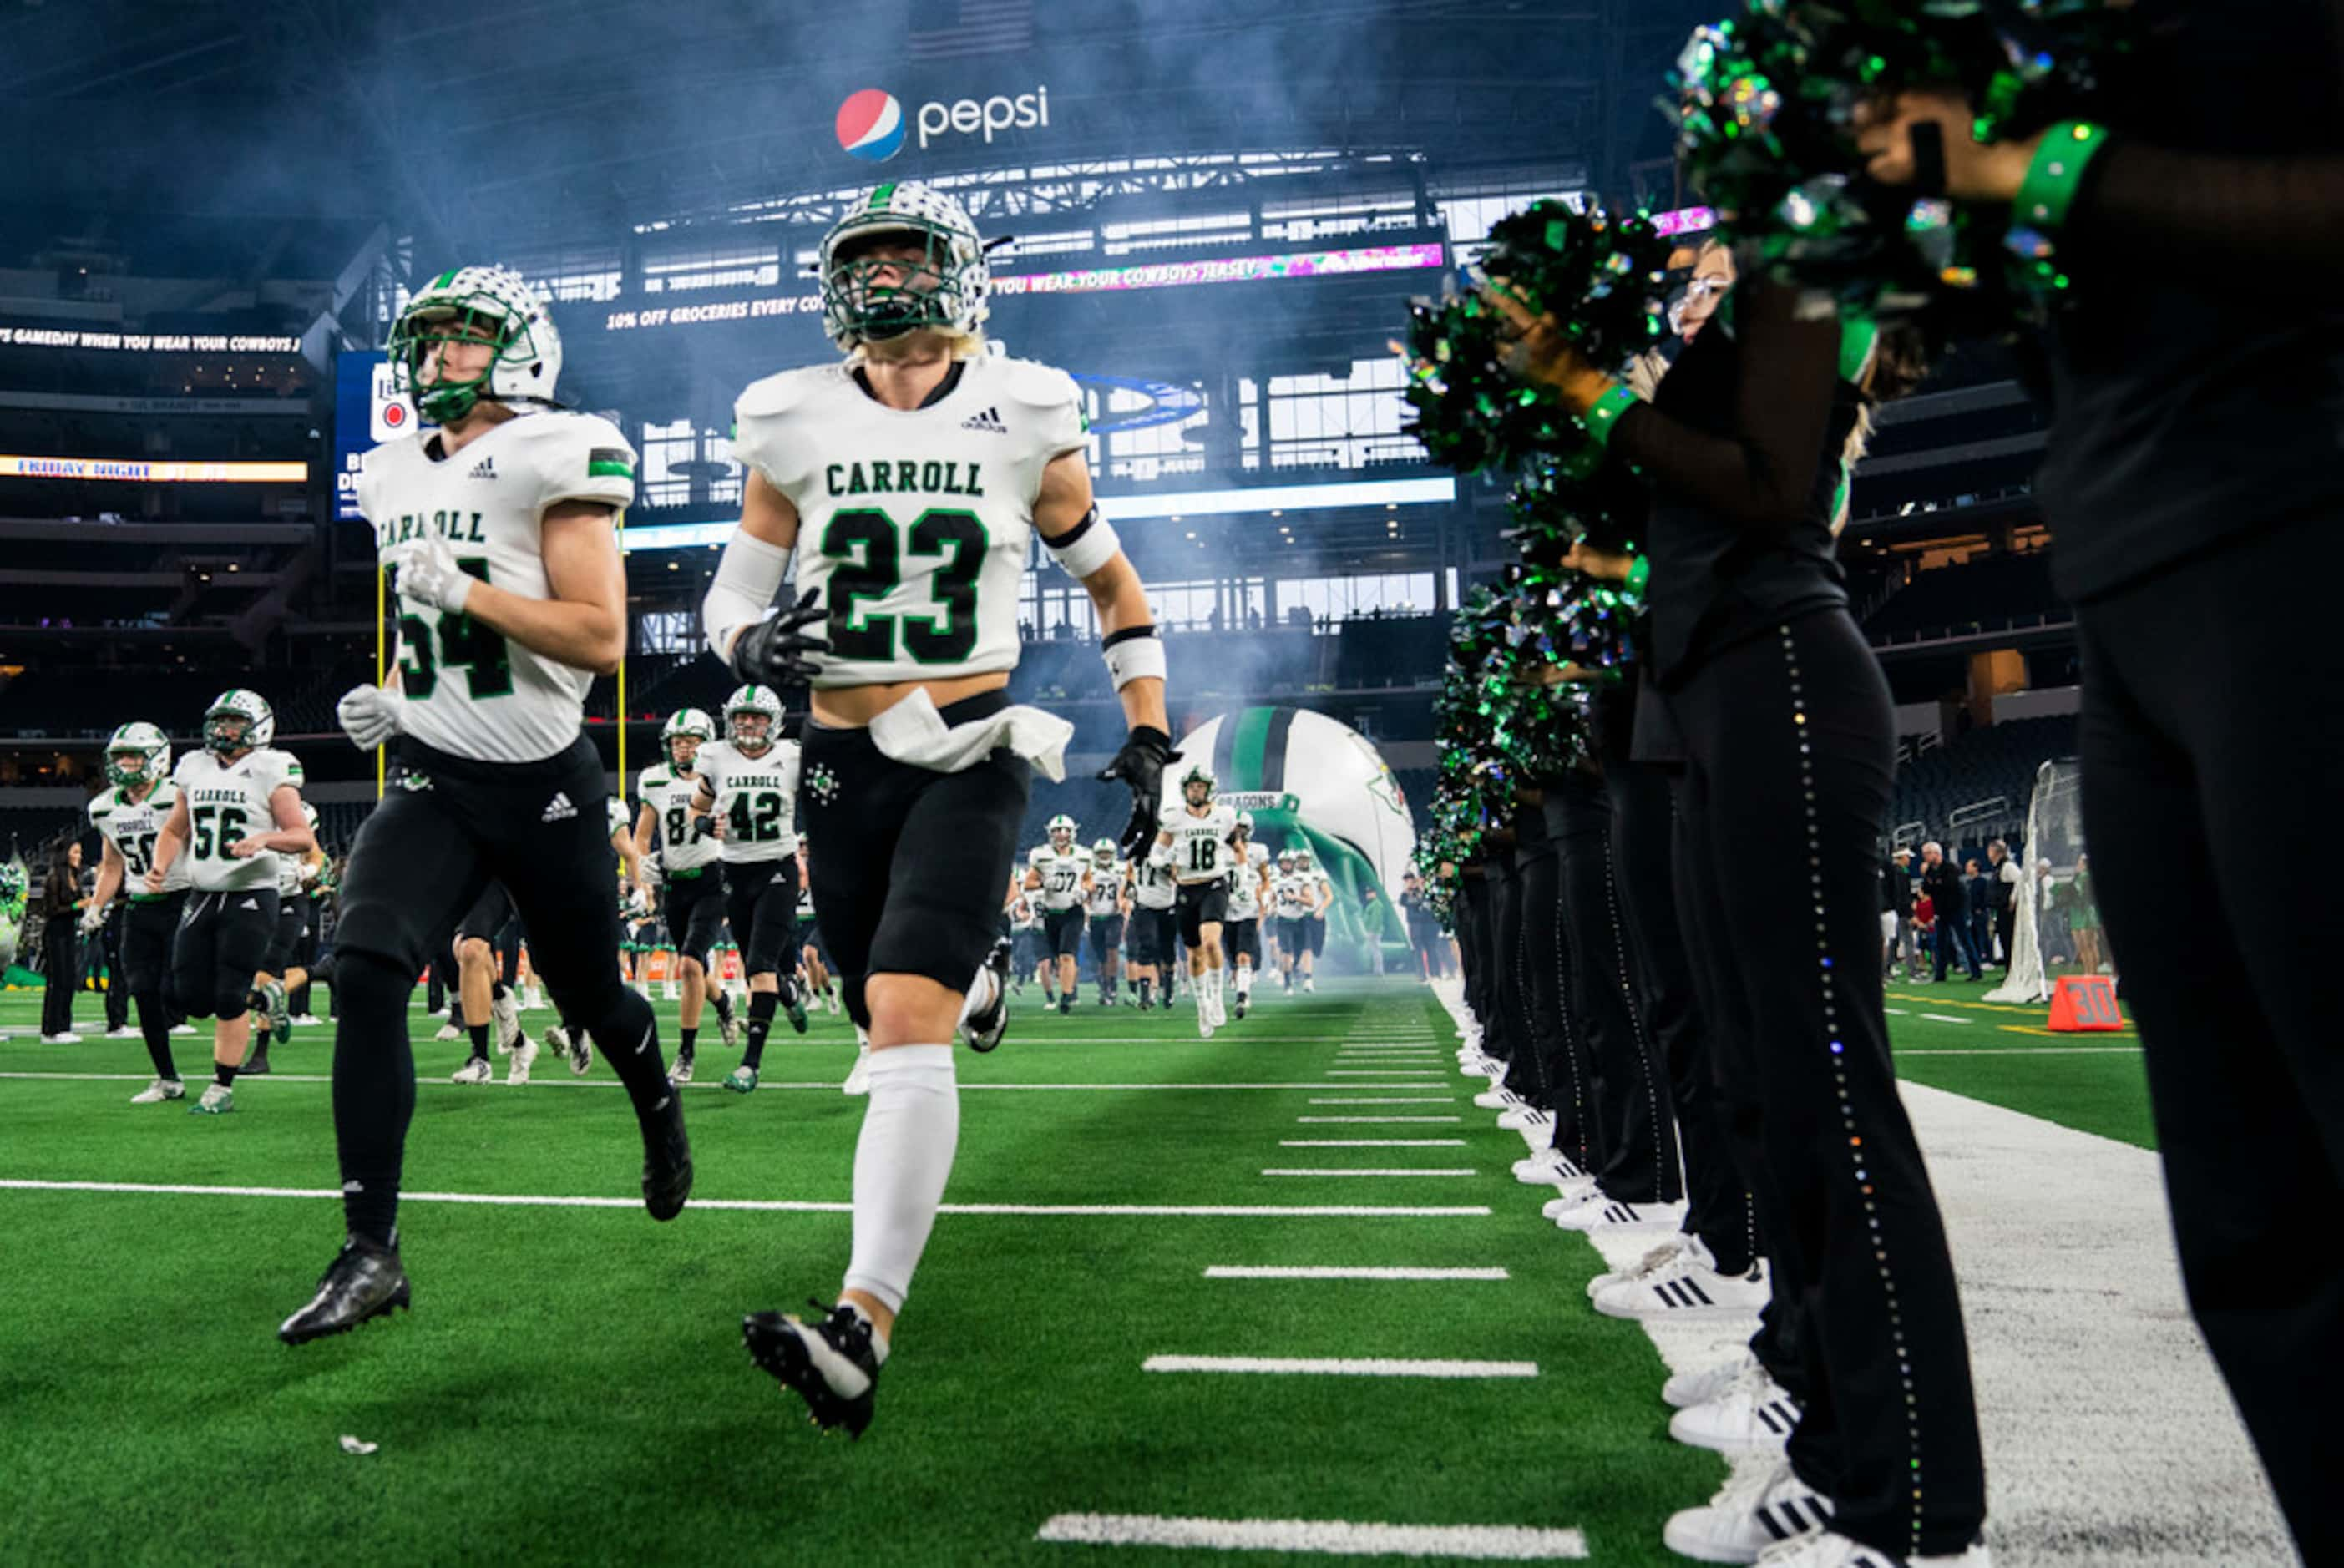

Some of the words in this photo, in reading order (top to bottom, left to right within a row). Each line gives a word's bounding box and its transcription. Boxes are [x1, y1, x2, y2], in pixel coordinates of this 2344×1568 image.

[918, 85, 1048, 149] pepsi
[606, 313, 636, 330] 10%
[640, 308, 667, 326] OFF
[670, 301, 749, 324] GROCERIES
[752, 296, 797, 317] EVERY
[996, 279, 1026, 295] YOU
[1031, 275, 1074, 292] WEAR
[1078, 270, 1120, 289] YOUR
[1125, 262, 1198, 286] COWBOYS
[1200, 259, 1257, 281] JERSEY
[13, 328, 79, 346] GAMEDAY
[80, 332, 121, 349] WHEN
[123, 334, 152, 351] YOU
[152, 335, 190, 351] WEAR
[192, 336, 228, 352] YOUR
[229, 336, 291, 352] COWBOYS
[17, 458, 86, 475] FRIDAY
[94, 462, 151, 478] NIGHT
[827, 461, 985, 497] CARROLL
[820, 507, 989, 664] 23
[194, 789, 246, 803] CARROLL
[727, 776, 781, 789] CARROLL
[193, 806, 248, 861] 56
[729, 792, 782, 841] 42
[1189, 838, 1217, 871] 18
[2068, 983, 2119, 1024] 30
